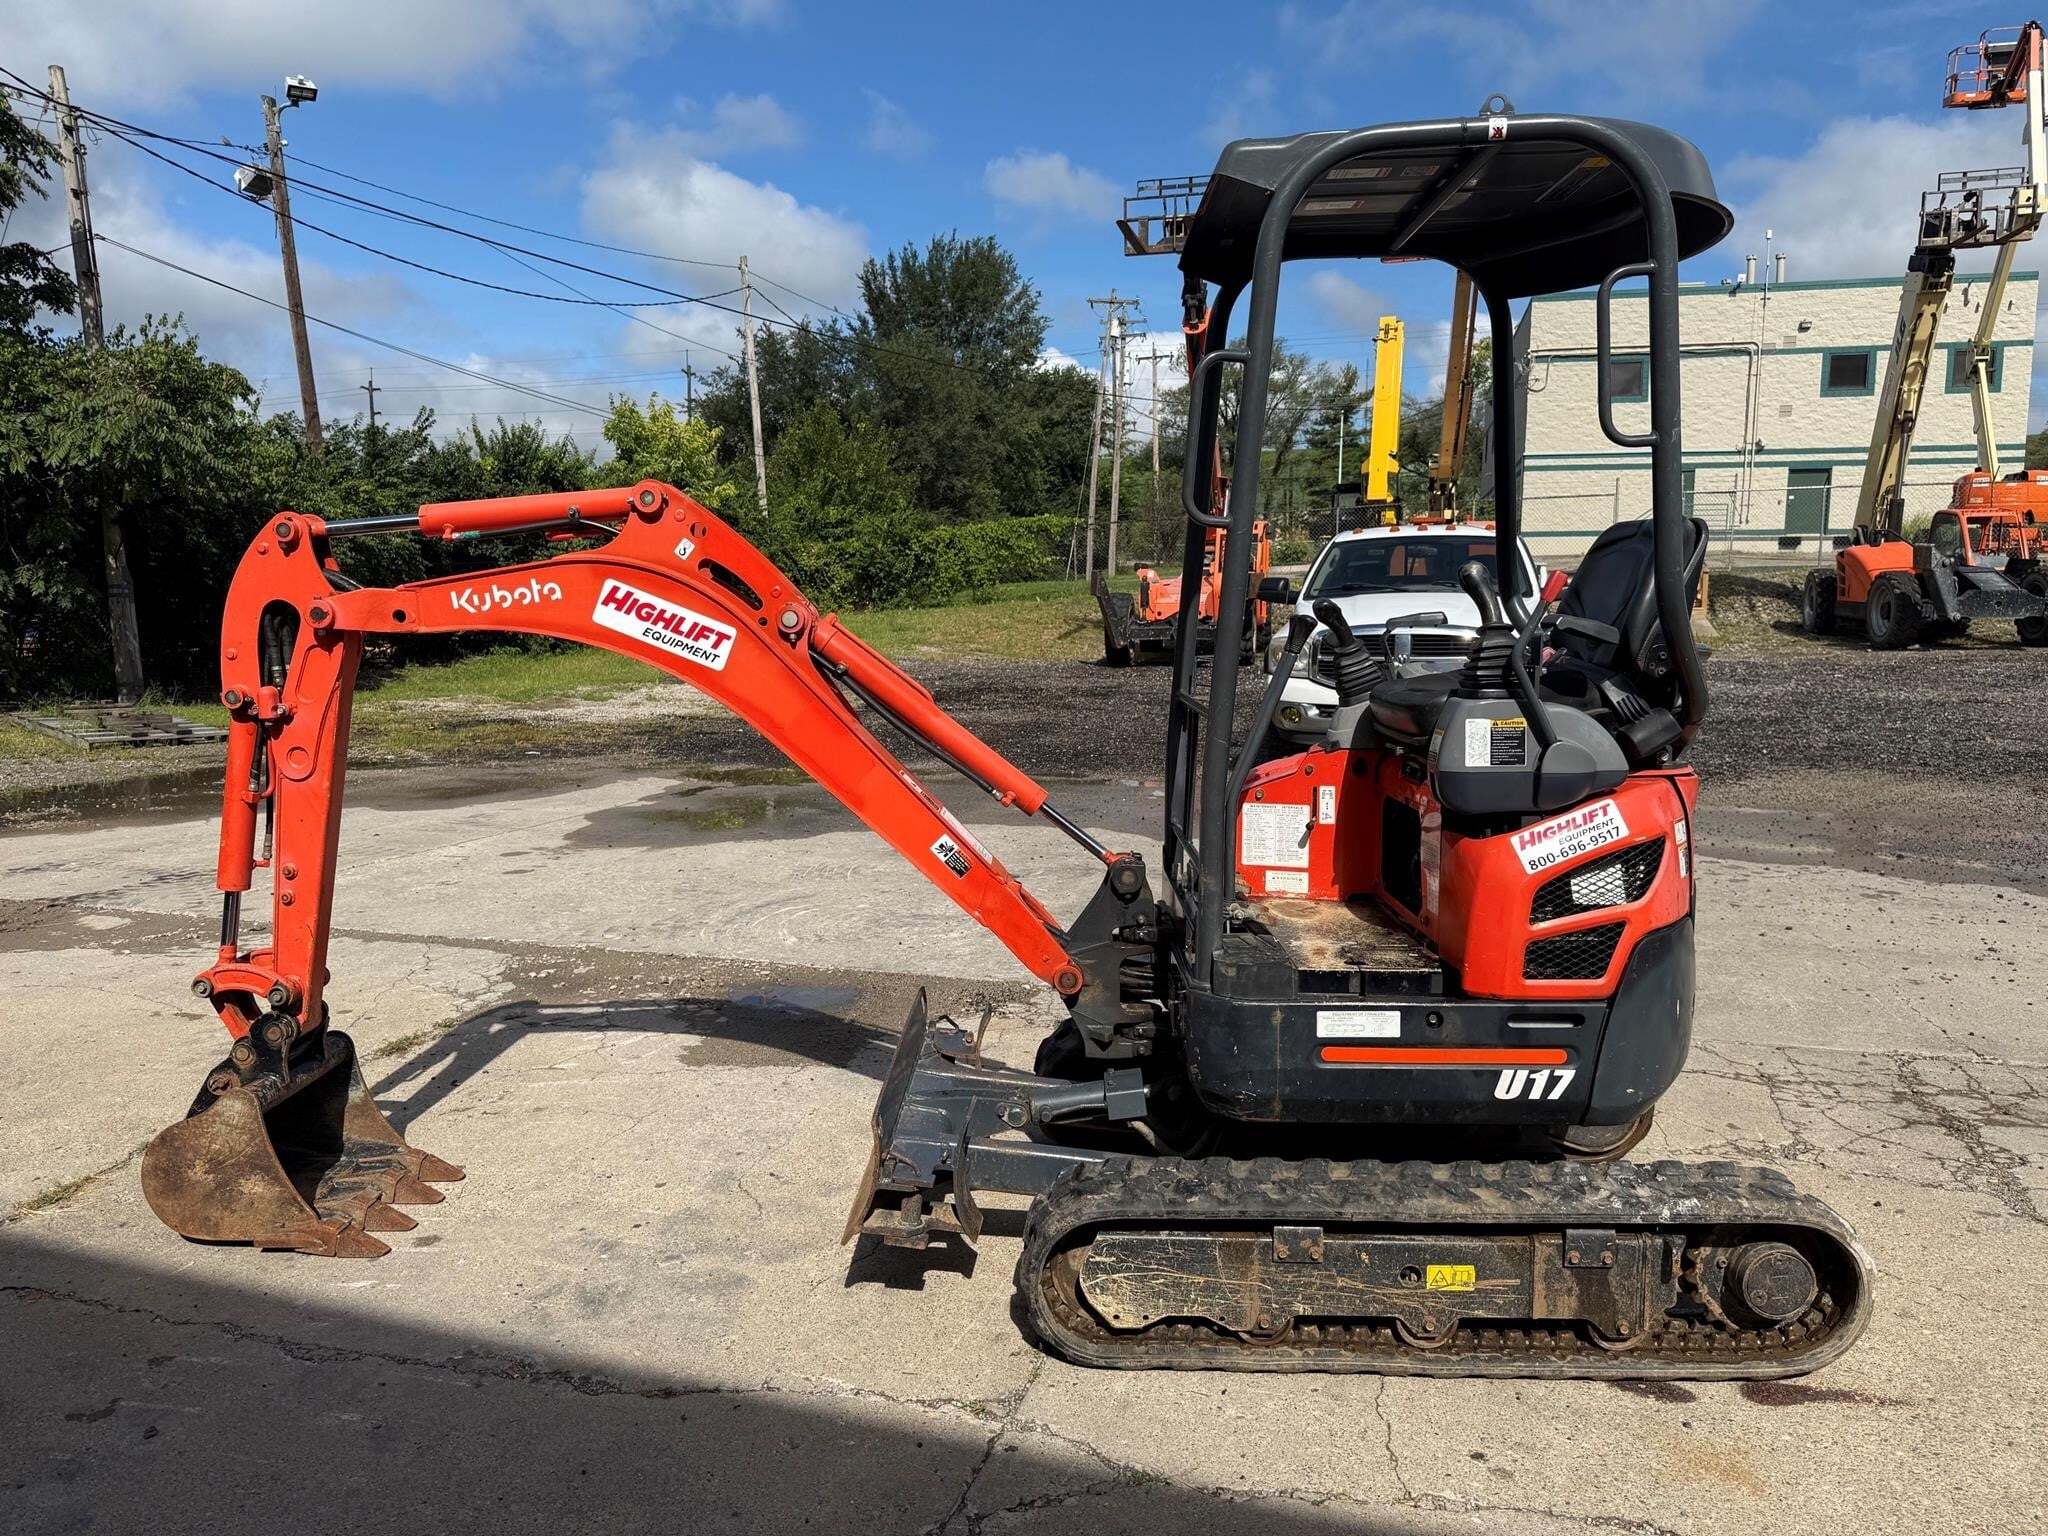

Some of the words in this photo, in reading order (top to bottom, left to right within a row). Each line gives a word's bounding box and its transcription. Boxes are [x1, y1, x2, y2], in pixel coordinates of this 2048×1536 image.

[450, 578, 563, 614] Kubota
[601, 585, 732, 651] HIGHLIFT
[642, 627, 720, 664] EQUIPMENT
[1518, 803, 1610, 851] HIGHLIFT
[1559, 817, 1615, 846] EQUIPMENT
[1528, 826, 1620, 871] 800-696-9517
[1494, 1069, 1577, 1100] U17
